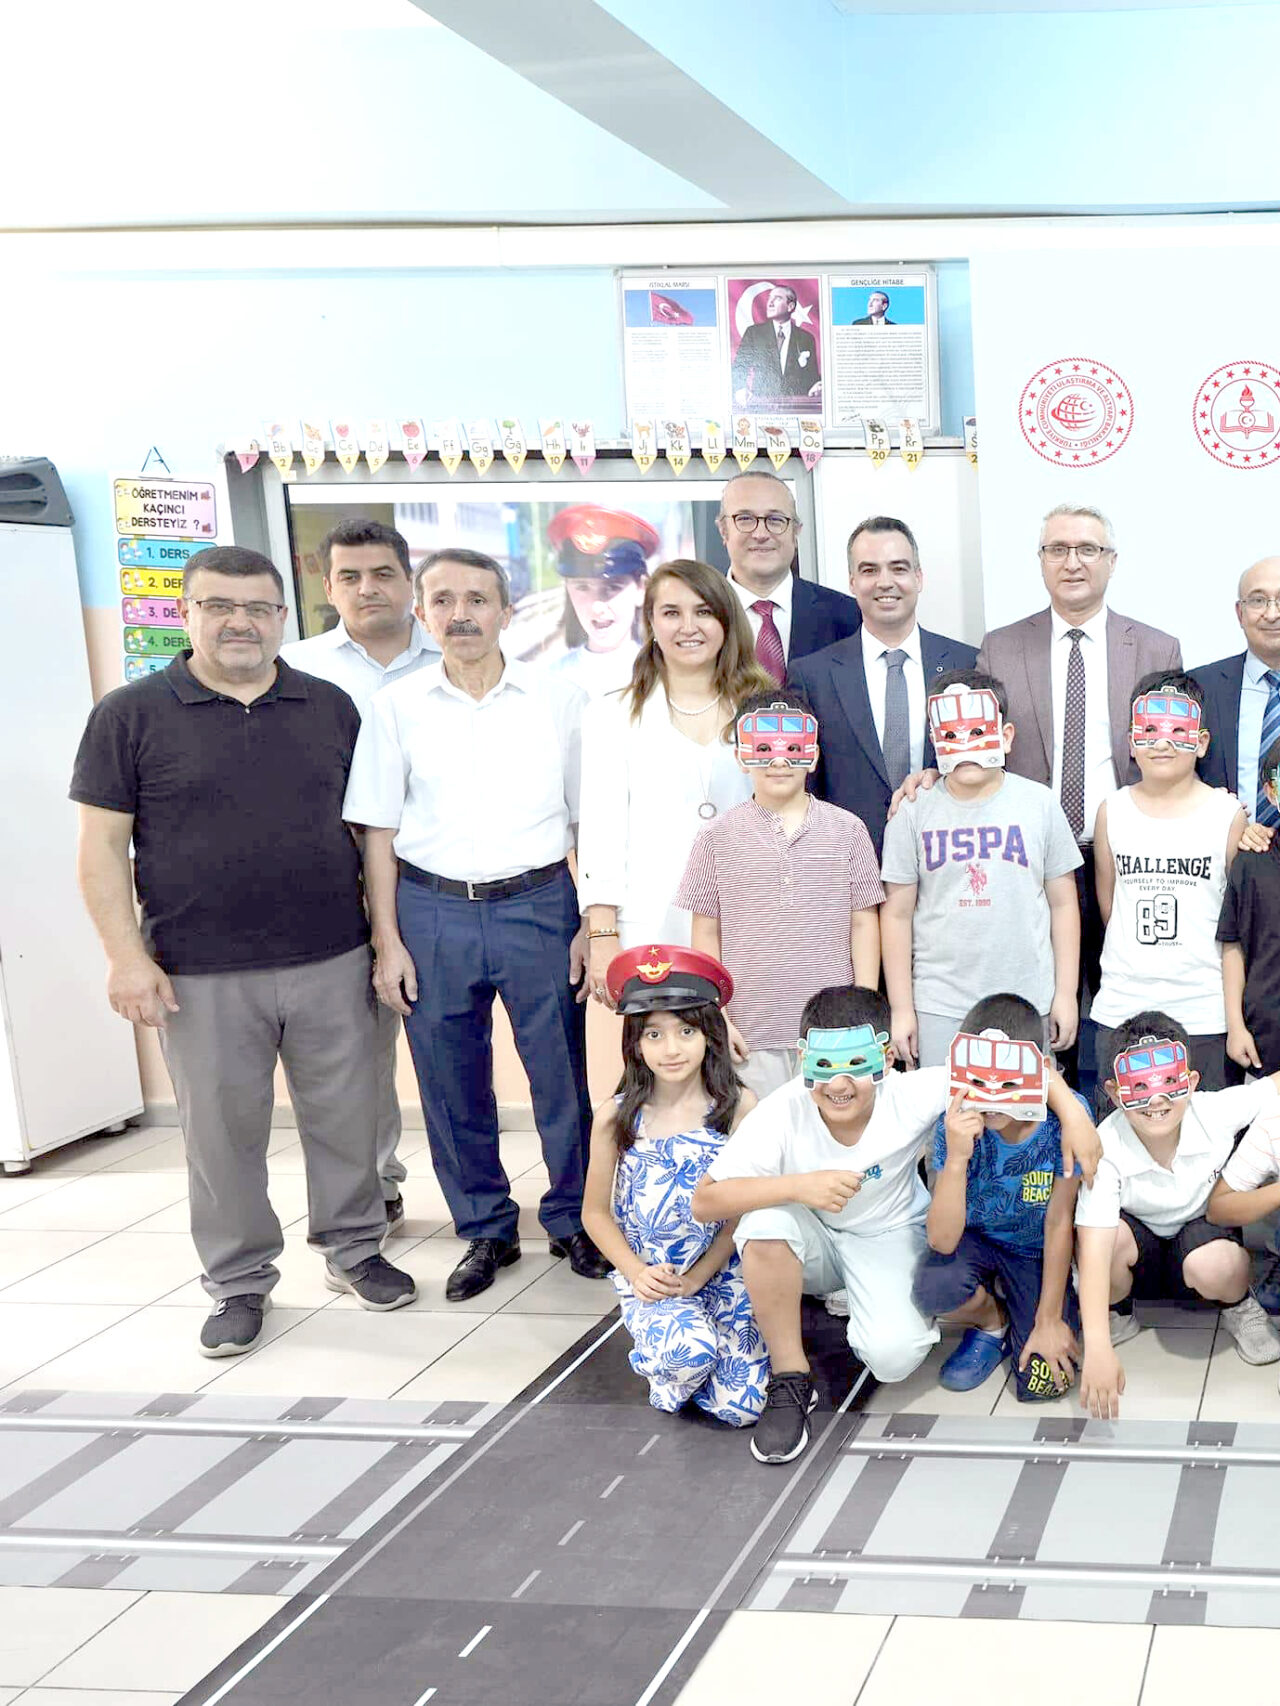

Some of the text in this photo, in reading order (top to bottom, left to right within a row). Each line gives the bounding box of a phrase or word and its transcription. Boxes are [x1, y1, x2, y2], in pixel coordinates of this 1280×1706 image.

[546, 440, 560, 450] Hh
[671, 440, 683, 451] Kk
[735, 436, 755, 448] Mm
[770, 437, 785, 447] Nn
[803, 435, 820, 448] Oo
[872, 434, 884, 450] Pp
[906, 436, 917, 447] Rr
[472, 442, 488, 457] Gg
[639, 440, 647, 455] Jj
[412, 456, 416, 464] 6
[550, 456, 560, 464] 10
[709, 456, 719, 464] 15
[740, 454, 750, 462] 16
[775, 454, 784, 462] 17
[806, 454, 815, 462] 18
[872, 451, 885, 460] 20
[907, 452, 917, 462] 21
[310, 459, 315, 467] 3
[449, 458, 455, 466] 7
[480, 459, 485, 467] 8
[581, 458, 588, 466] 11
[640, 457, 649, 465] 13
[674, 458, 683, 466] 14
[131, 486, 198, 500] ÖĞRETMENİM
[143, 503, 184, 515] KAÇINCI
[131, 517, 187, 529] DERSTEYİZ
[147, 547, 190, 559] 1. DERS
[148, 577, 158, 588] 2.
[149, 607, 180, 618] 3. DE
[148, 636, 158, 646] 4.
[921, 825, 1028, 872] USPA
[1116, 854, 1212, 880] CHALLENGE
[959, 899, 974, 907] EST.
[1136, 894, 1178, 945] 89
[1023, 1186, 1052, 1202] BEAC
